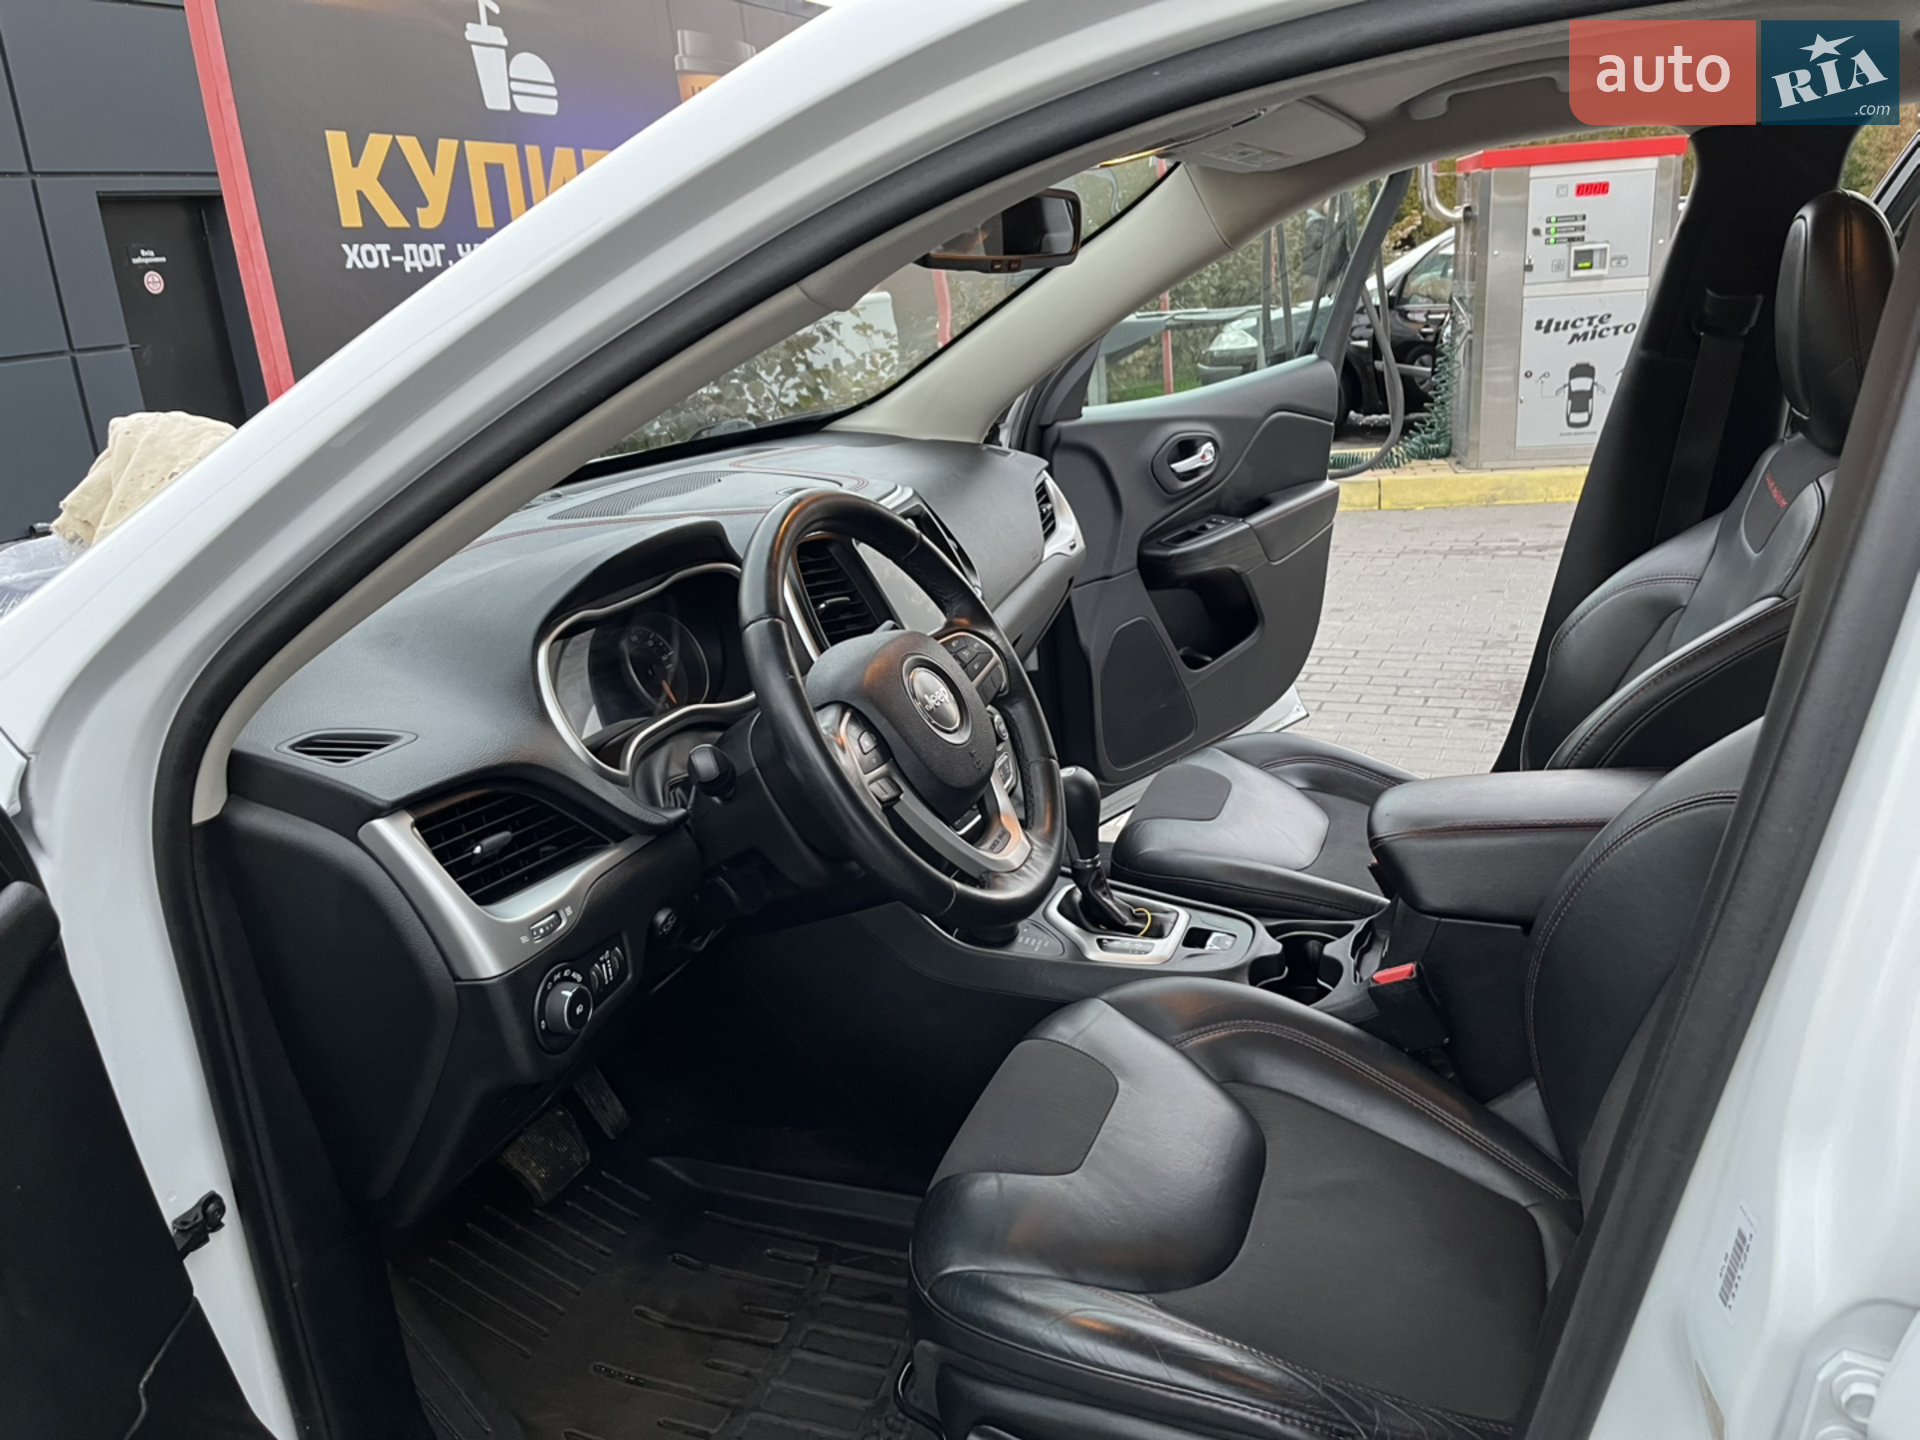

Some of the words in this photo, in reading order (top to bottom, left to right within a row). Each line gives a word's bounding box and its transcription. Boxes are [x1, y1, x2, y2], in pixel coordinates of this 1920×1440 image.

[325, 129, 612, 229] КУПИ
[1534, 313, 1612, 334] Чисте
[1567, 322, 1637, 345] місто
[924, 687, 950, 711] Jeep
